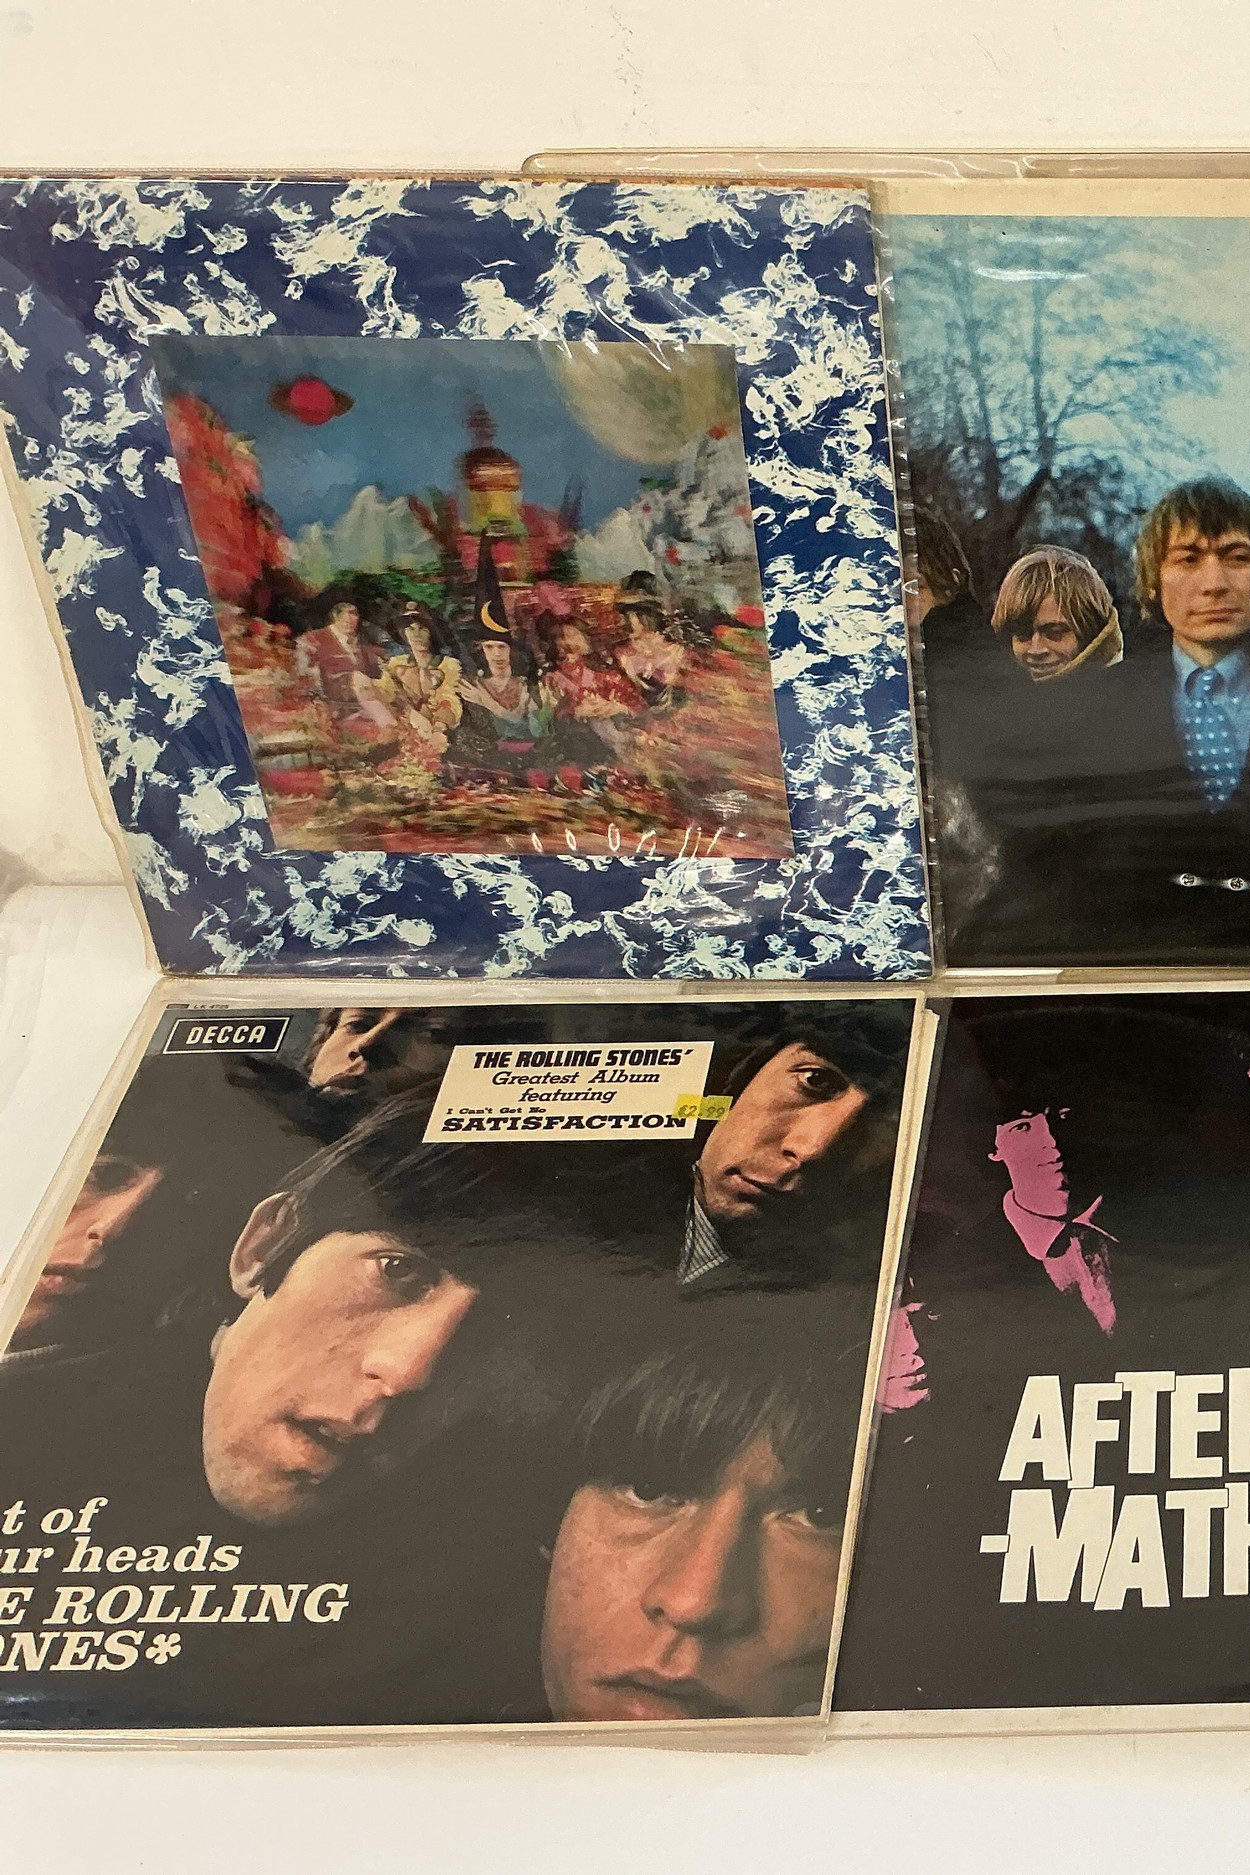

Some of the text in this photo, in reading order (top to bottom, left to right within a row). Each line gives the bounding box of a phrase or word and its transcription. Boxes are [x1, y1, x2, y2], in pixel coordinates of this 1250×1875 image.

[185, 1025, 266, 1045] DECCA
[474, 1048, 694, 1069] THE ROLLING STONES'
[492, 1069, 661, 1086] Greatest Album
[518, 1087, 618, 1104] featuring
[459, 1107, 493, 1115] Can't
[528, 1106, 547, 1114] No
[441, 1114, 687, 1132] SATISFACTION
[40, 1496, 109, 1534] of
[62, 1534, 243, 1573] heads
[42, 1582, 349, 1626] ROLLING
